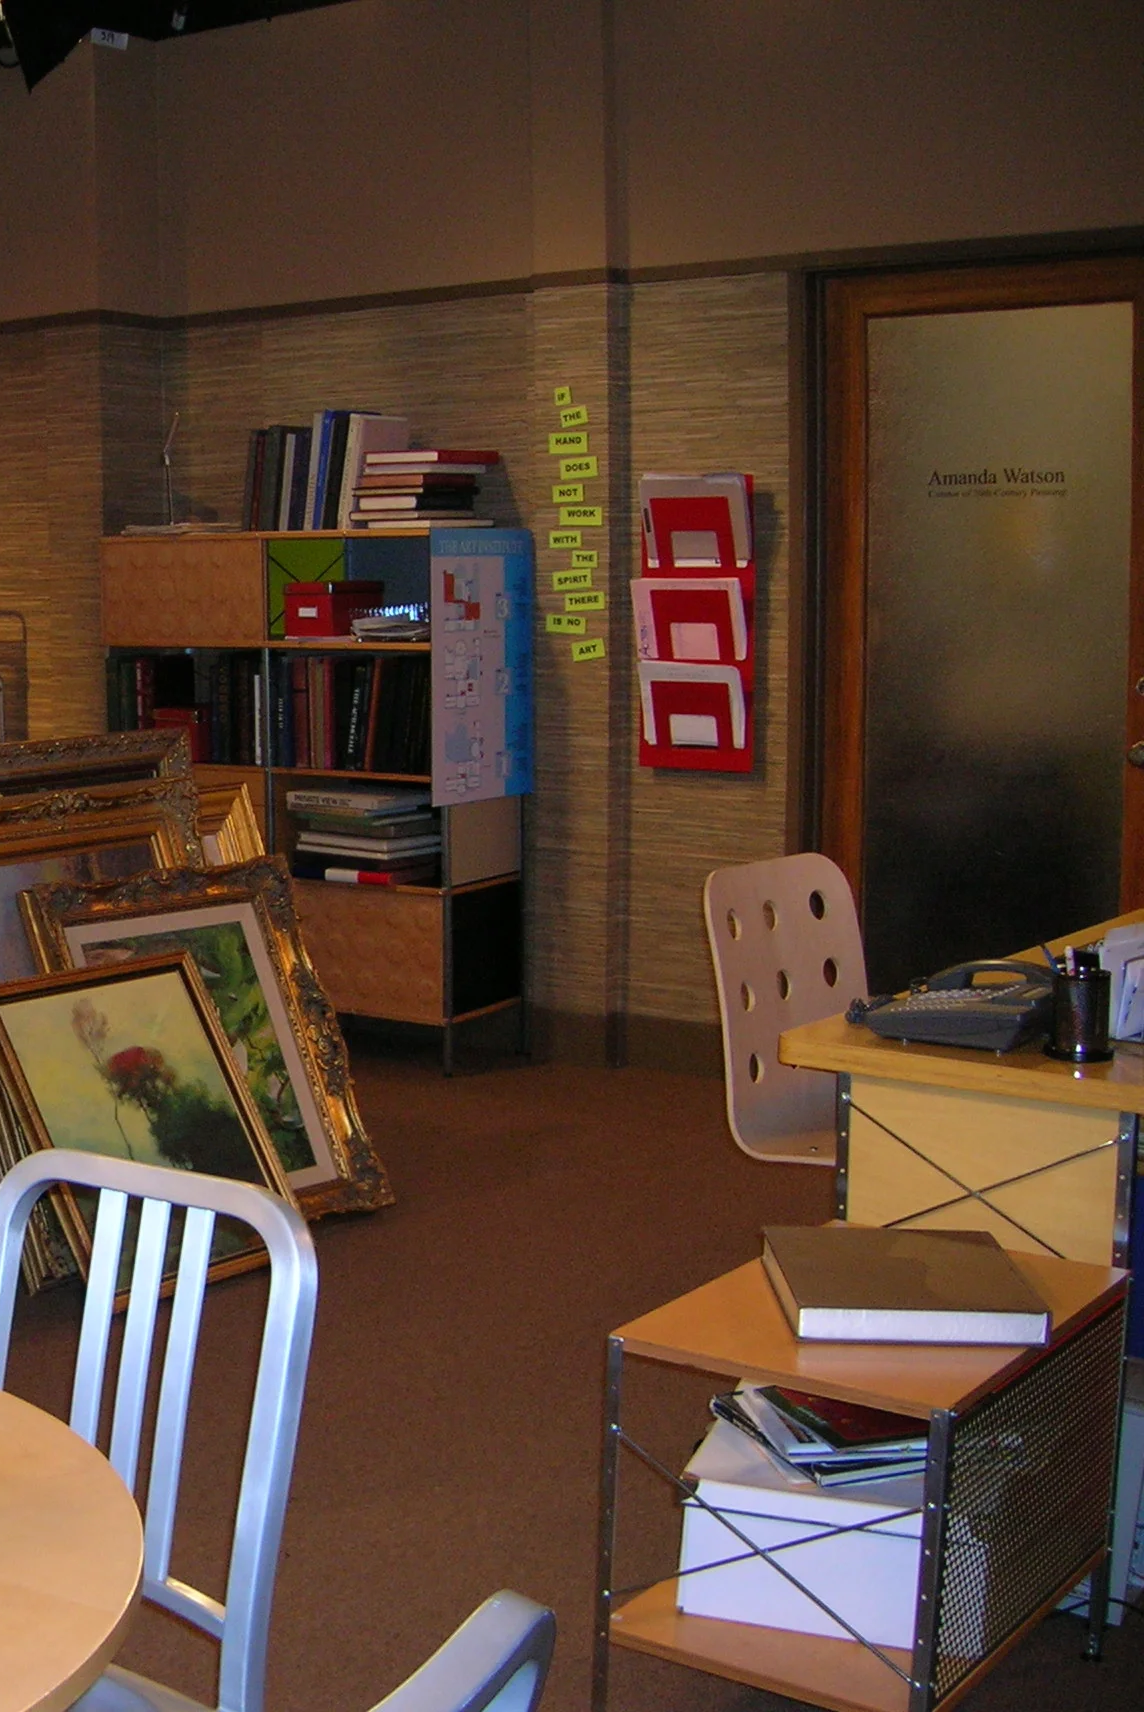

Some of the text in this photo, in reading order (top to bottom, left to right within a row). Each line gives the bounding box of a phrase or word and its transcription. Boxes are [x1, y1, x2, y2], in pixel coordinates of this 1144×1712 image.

[563, 410, 582, 422] THE
[555, 436, 582, 446] HAND
[565, 462, 591, 472] DOES
[928, 467, 1066, 486] Amanda Watson
[558, 488, 578, 497] NOT
[567, 509, 597, 518] WORK
[552, 535, 578, 544] WITH
[576, 554, 595, 563] THE
[557, 574, 588, 585] SPIRIT
[568, 595, 599, 605] THERE
[553, 617, 581, 627] IS NO
[578, 644, 598, 656] ART
